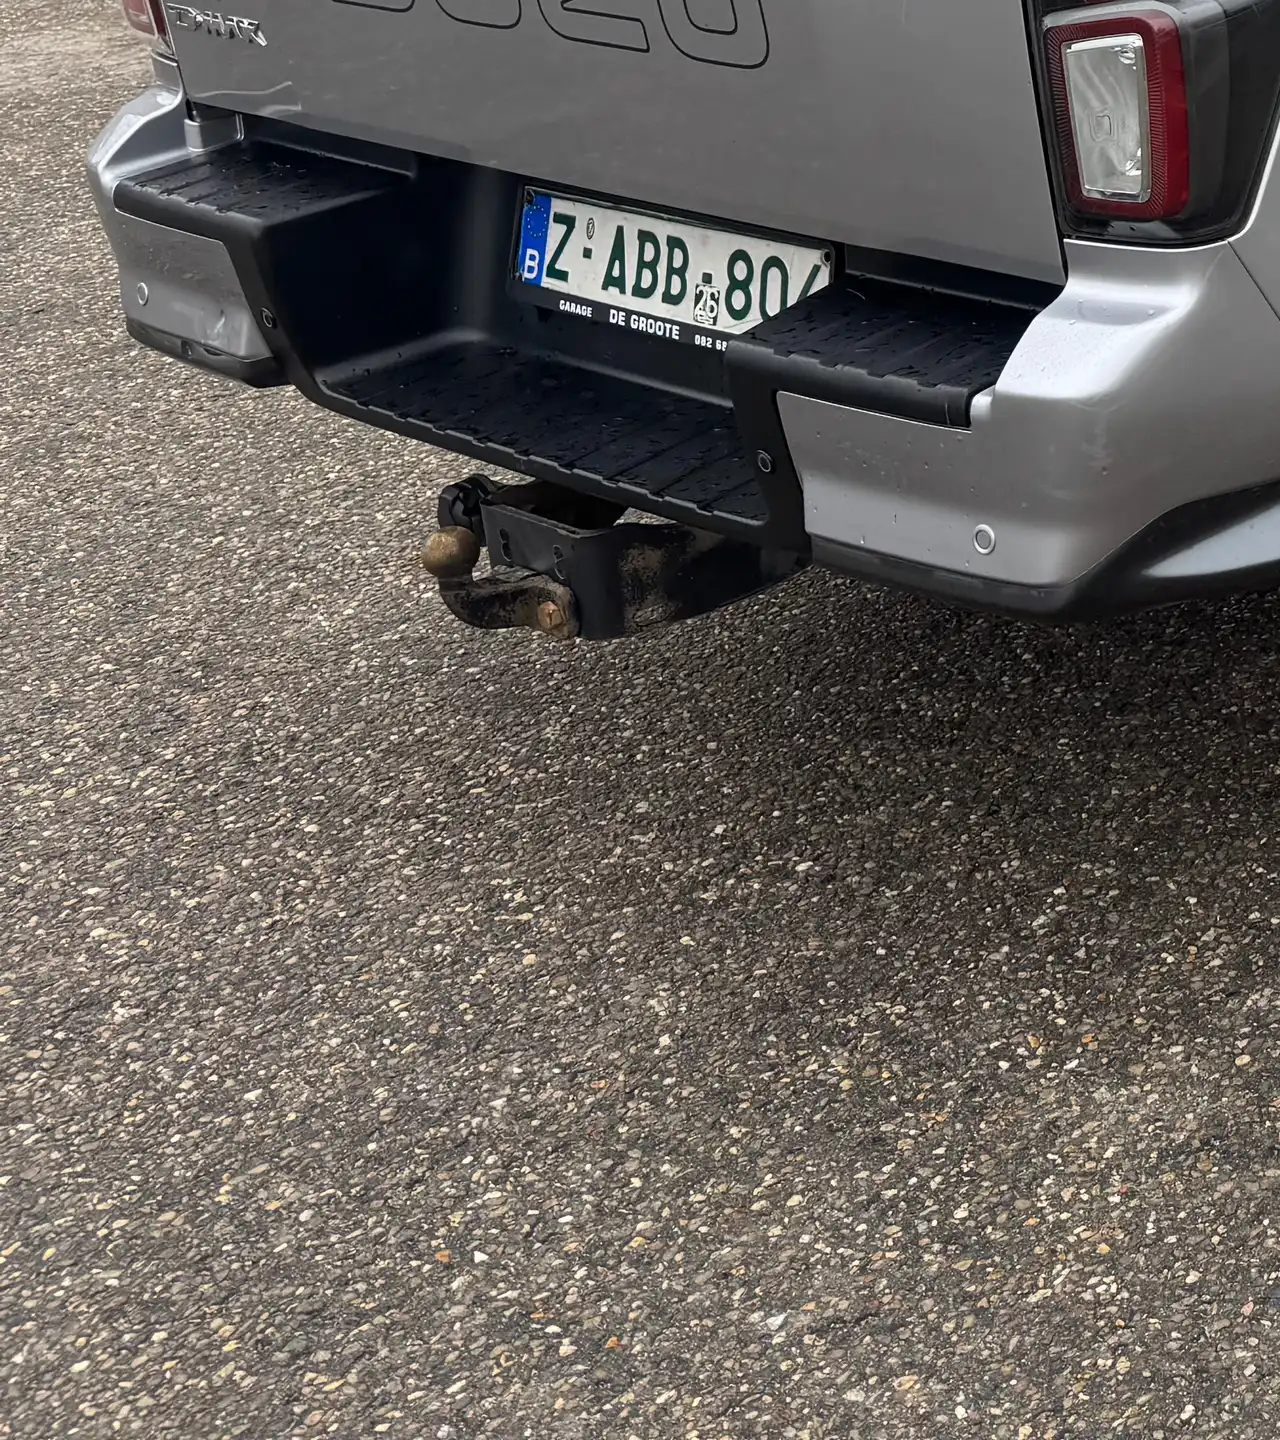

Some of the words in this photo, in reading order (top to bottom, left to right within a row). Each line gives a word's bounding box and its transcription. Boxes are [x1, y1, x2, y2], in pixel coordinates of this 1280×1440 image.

[524, 248, 539, 280] B
[559, 299, 593, 318] GARAGE
[609, 308, 628, 327] DE
[630, 314, 680, 340] GROOTE
[694, 334, 713, 348] 082
